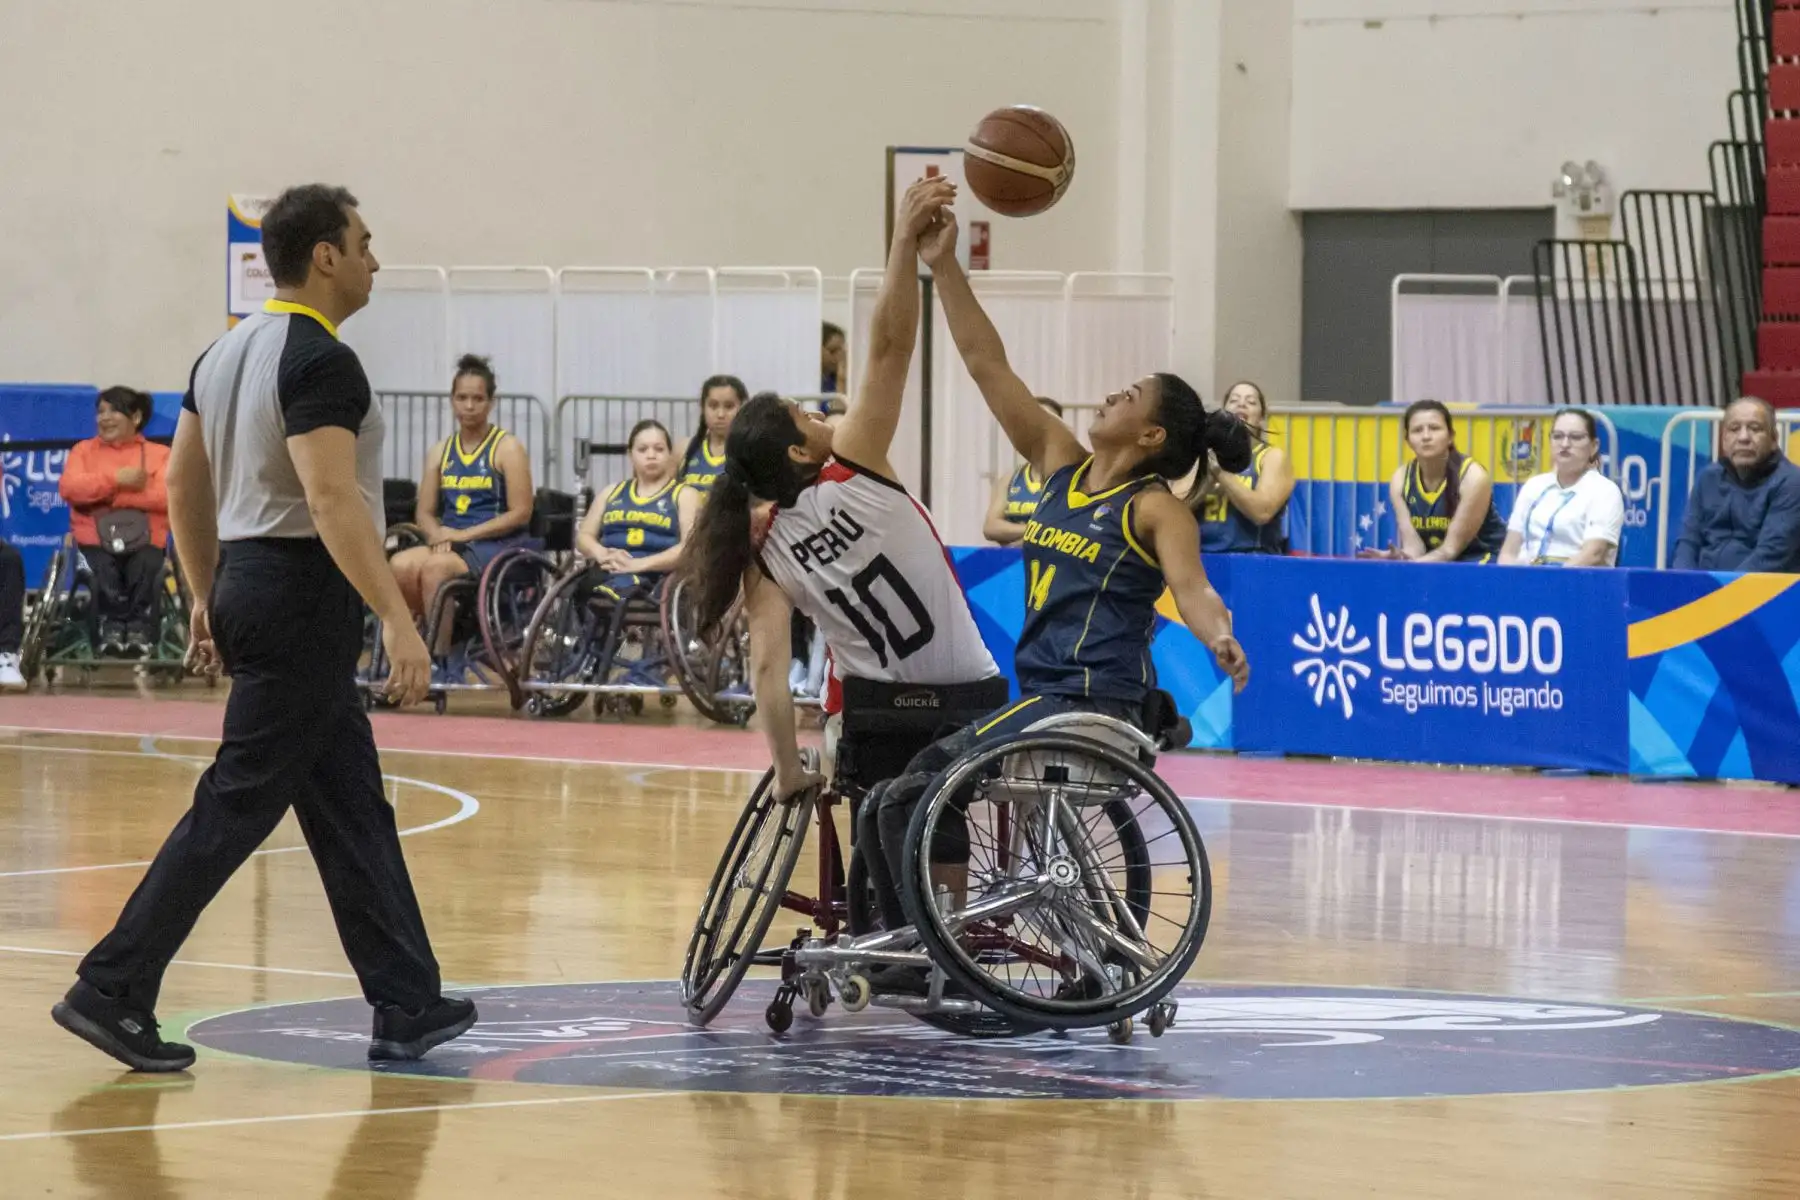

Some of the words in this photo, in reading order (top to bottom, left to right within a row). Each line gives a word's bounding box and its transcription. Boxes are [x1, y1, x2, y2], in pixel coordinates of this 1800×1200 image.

[603, 509, 672, 528] COLOMBIA
[790, 507, 864, 573] PERÚ
[1027, 559, 1057, 611] 14
[824, 552, 935, 668] 10
[893, 697, 941, 708] QUICKIE
[1380, 677, 1478, 714] Seguimos
[1483, 681, 1564, 717] jugando
